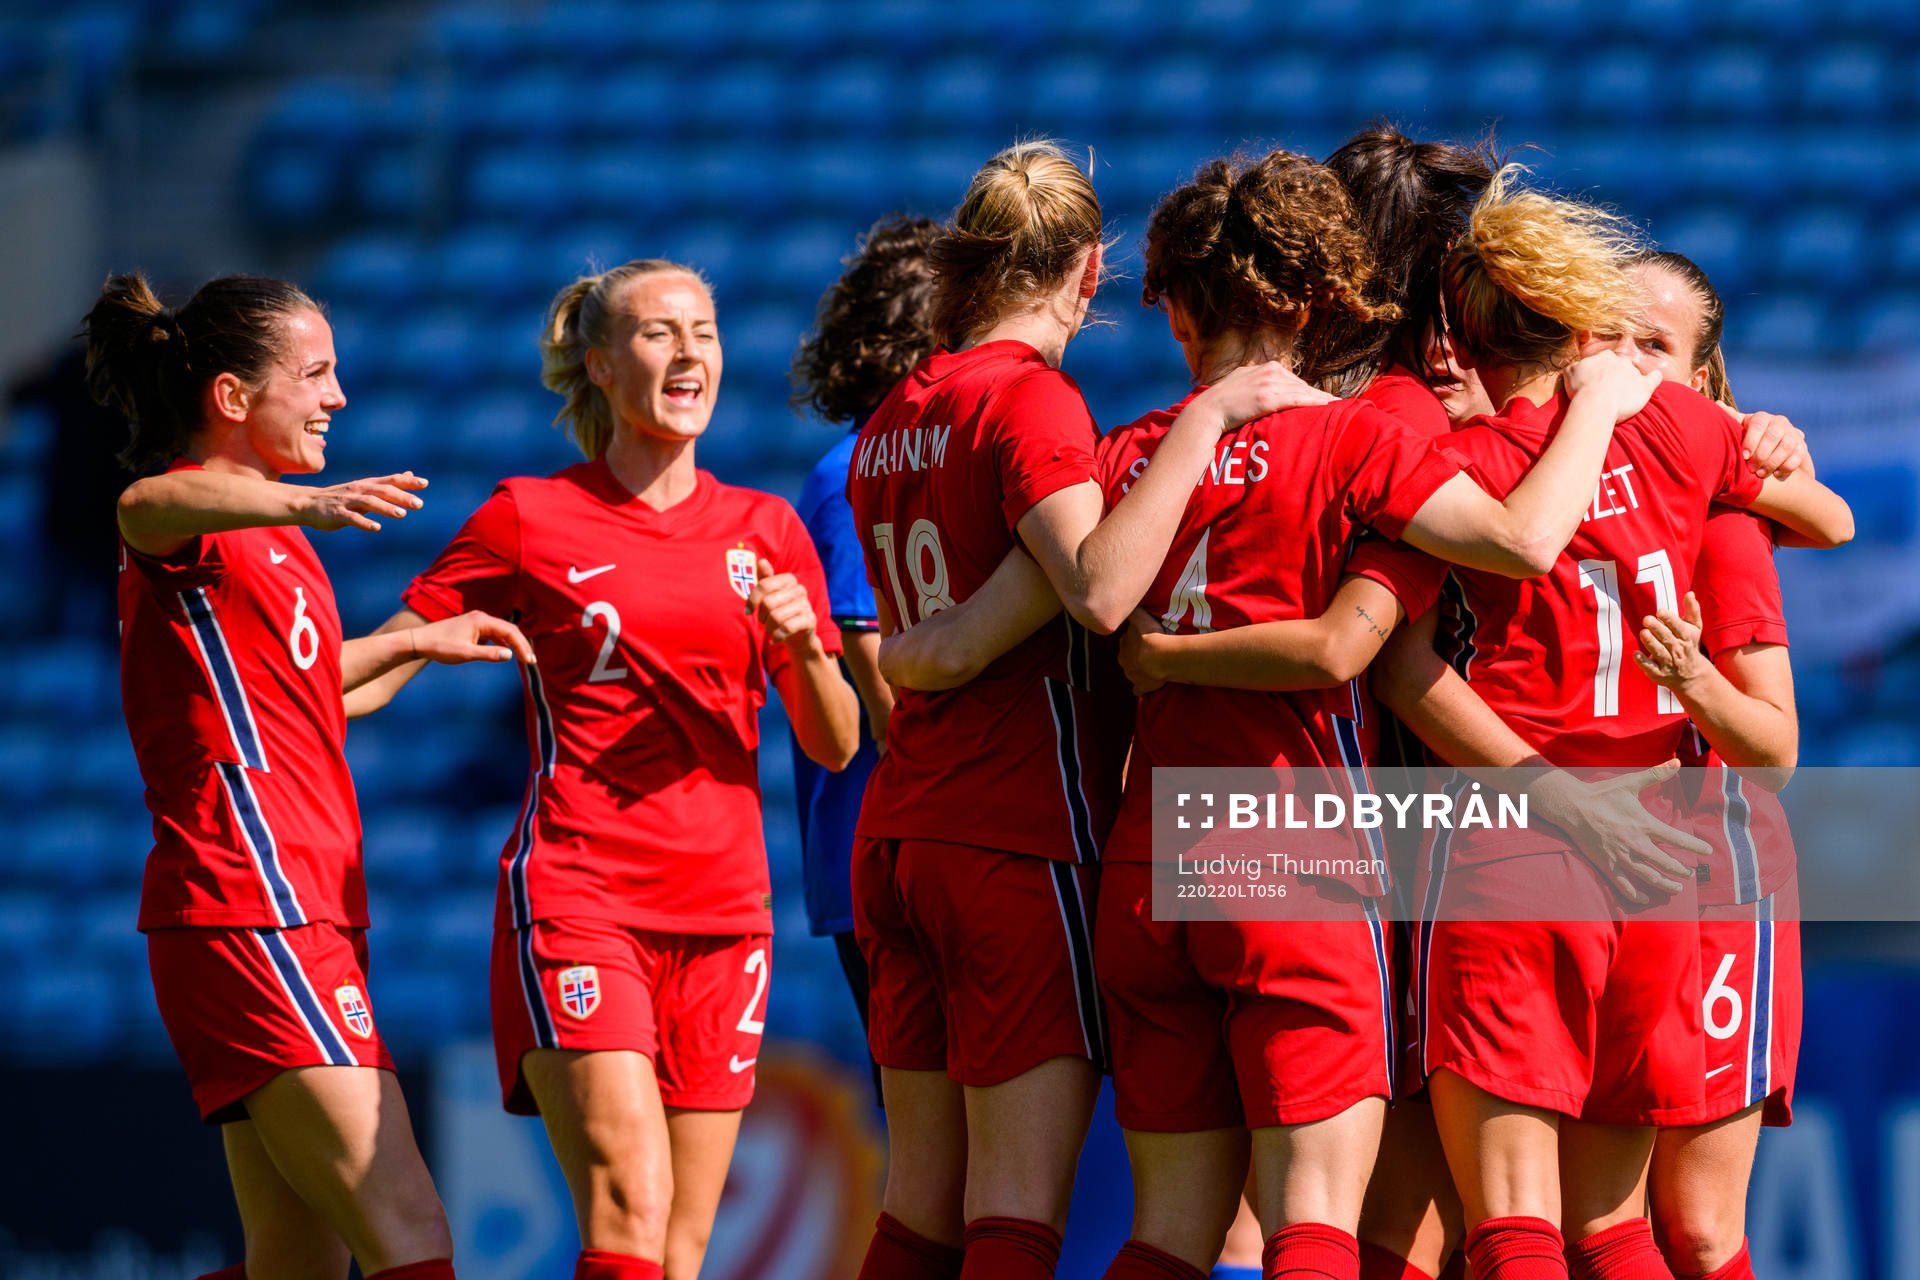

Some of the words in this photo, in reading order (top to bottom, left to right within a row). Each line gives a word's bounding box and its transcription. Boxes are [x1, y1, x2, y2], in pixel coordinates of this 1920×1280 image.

[873, 518, 956, 630] 18
[1161, 526, 1216, 634] 4
[290, 587, 319, 670] 6
[581, 601, 628, 683] 2
[1578, 549, 1685, 717] 11
[735, 949, 768, 1035] 2
[1702, 953, 1743, 1040] 6
